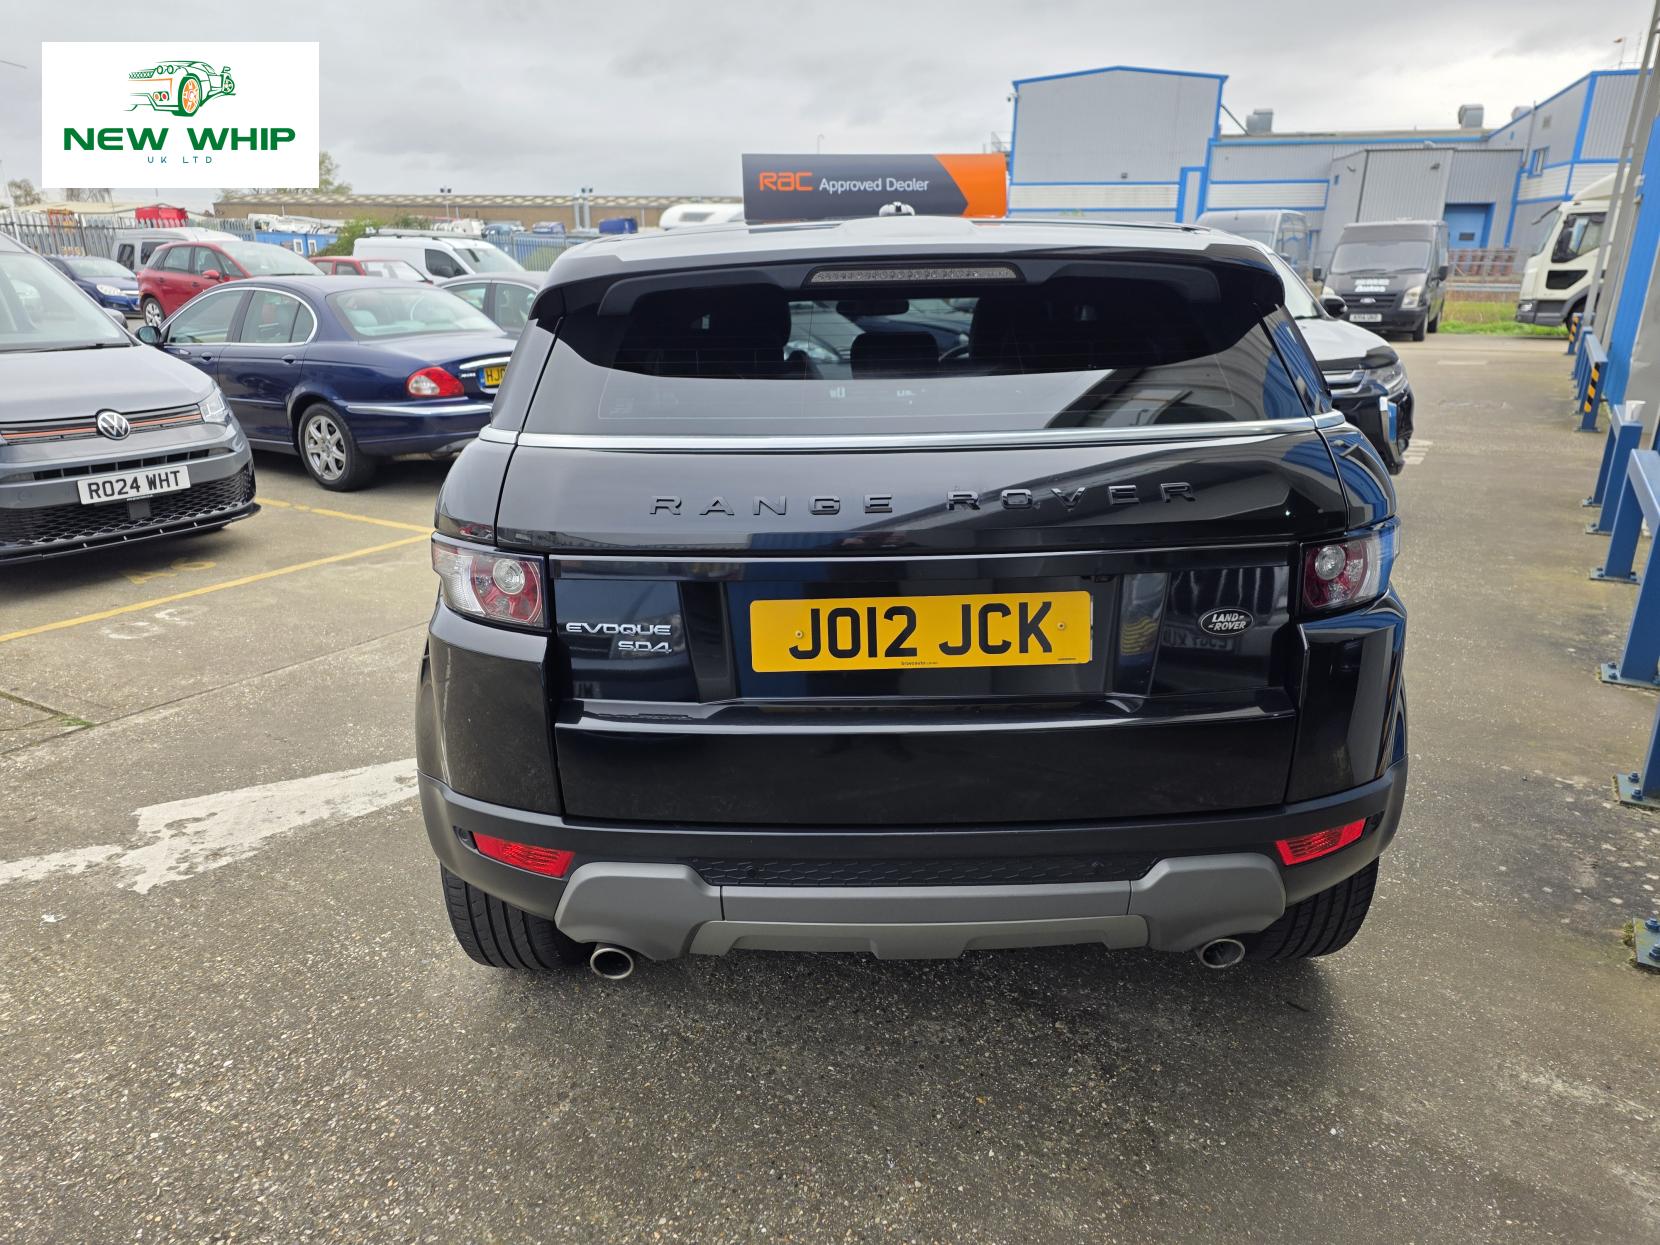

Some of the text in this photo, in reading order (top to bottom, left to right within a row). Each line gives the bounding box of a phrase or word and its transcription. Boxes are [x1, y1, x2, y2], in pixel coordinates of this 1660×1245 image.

[819, 177, 882, 195] Approved
[886, 177, 930, 192] Dealer
[87, 470, 180, 500] RO24 WHT
[649, 481, 1197, 516] RANGE ROVER
[1212, 613, 1239, 622] LAND
[565, 622, 672, 636] EVOQUE
[788, 600, 1053, 660] JO12 JCK
[1213, 621, 1247, 631] ROVER
[617, 640, 673, 653] SD4
